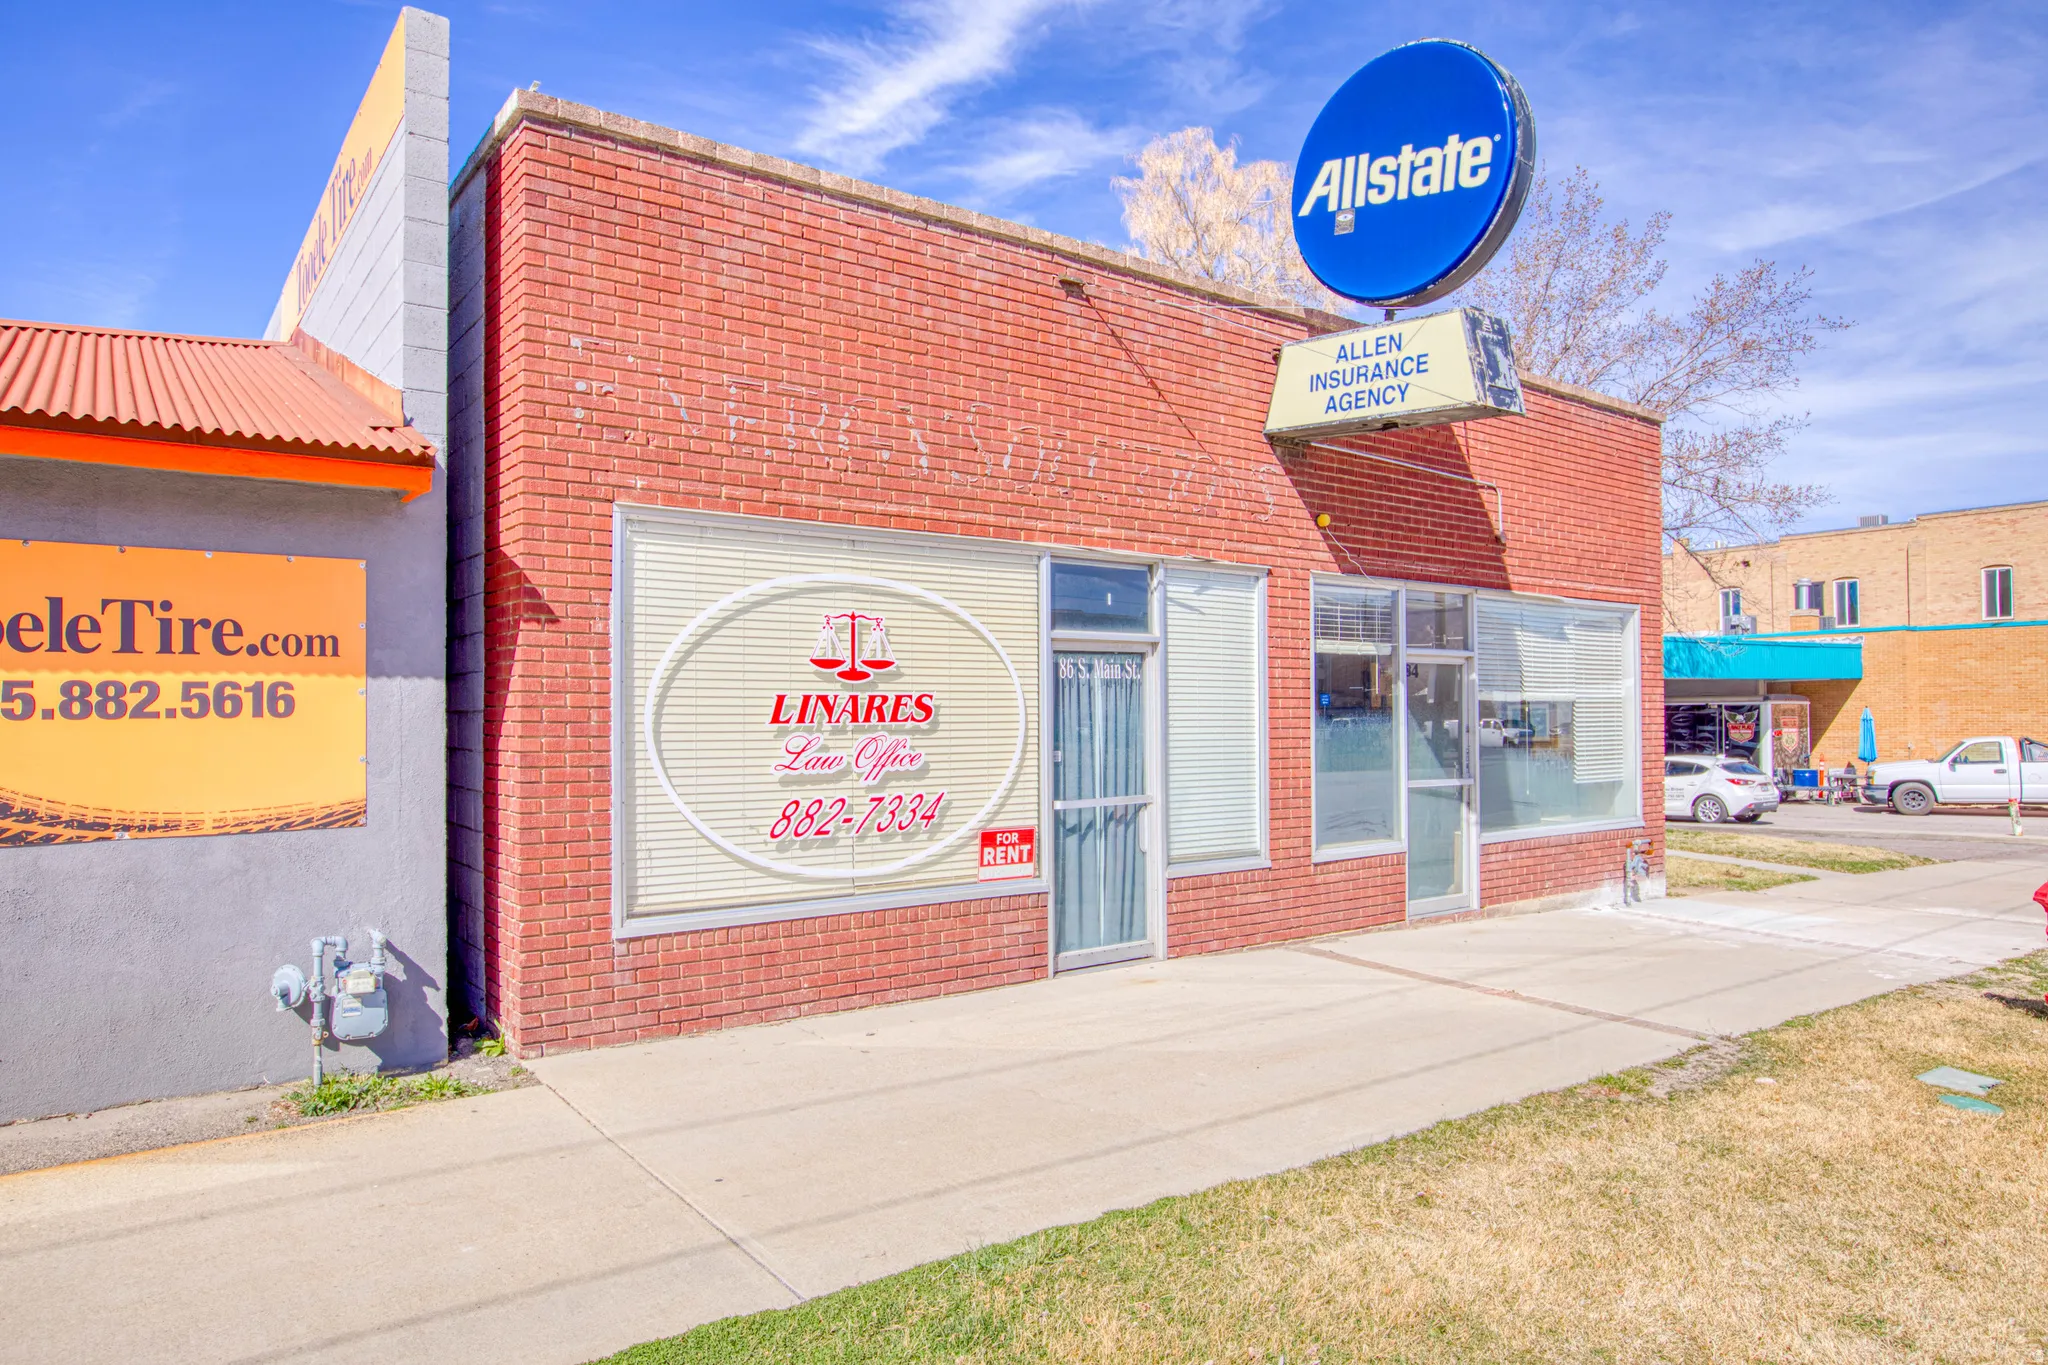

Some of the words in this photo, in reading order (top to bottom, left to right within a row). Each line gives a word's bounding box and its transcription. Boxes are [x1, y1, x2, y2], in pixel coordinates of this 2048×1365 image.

[1298, 134, 1492, 216] Allstate
[1336, 332, 1402, 364] ALLEN
[1309, 353, 1429, 392] INSURANCE
[1324, 383, 1410, 414] AGENCY
[0, 596, 340, 657] eleTire.com
[1059, 657, 1074, 679] 86
[1078, 657, 1090, 679] S.
[1094, 658, 1121, 679] Main
[1125, 658, 1141, 680] St.
[0, 680, 295, 720] 5.882.5616
[768, 693, 934, 725] LINARES
[774, 735, 844, 771] Law
[854, 734, 922, 781] Office
[769, 791, 946, 840] 882-7334
[983, 844, 1031, 866] RENT
[996, 832, 1019, 846] FOR
